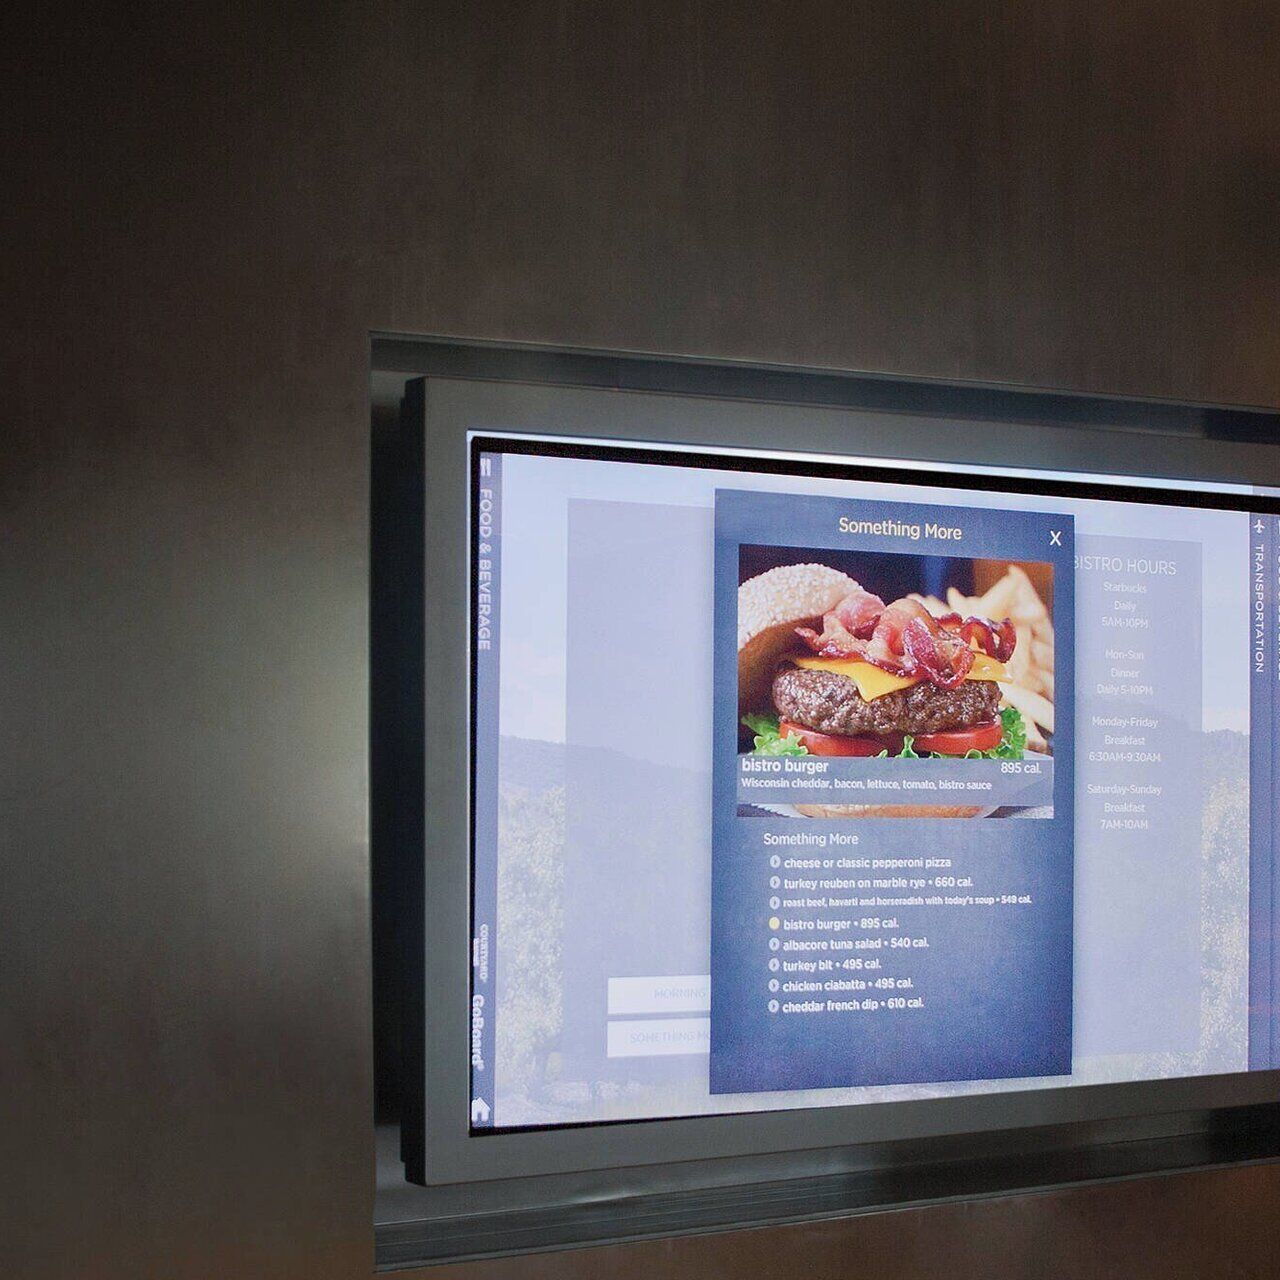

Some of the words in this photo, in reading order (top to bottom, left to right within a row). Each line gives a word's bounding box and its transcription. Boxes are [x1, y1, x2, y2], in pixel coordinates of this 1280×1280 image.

[480, 488, 492, 538] FOOD
[839, 517, 920, 539] Something
[925, 523, 962, 540] More
[480, 543, 491, 554] &
[1127, 559, 1176, 576] HOURS
[1104, 582, 1147, 594] Starbucks
[478, 559, 491, 650] BEVERAGE
[1114, 600, 1136, 613] Daily
[1255, 544, 1264, 673] TRANSPORTATION
[1102, 617, 1149, 629] 5AM-10PM
[1105, 650, 1144, 661] Mon-Sun
[1111, 668, 1141, 679] Dinner
[1097, 684, 1119, 697] Daily
[1120, 685, 1153, 696] 5-10PM
[1092, 717, 1159, 729] Monday-Friday
[1105, 735, 1146, 746] Breakfast
[742, 758, 781, 772] bistro
[785, 760, 829, 775] burger
[1001, 762, 1021, 773] 895
[1024, 762, 1042, 774] cal.
[742, 778, 789, 789] Wisconsin
[791, 778, 833, 790] cheddar,
[835, 779, 865, 790] bacon,
[867, 779, 900, 791] lettuce,
[902, 780, 937, 791] tomato,
[939, 780, 964, 790] bistro
[966, 782, 992, 791] sauce
[1087, 784, 1162, 797] Saturday-Sunday
[1104, 802, 1145, 813] Breakfast
[1101, 819, 1148, 830] 7AM-10AM
[764, 833, 826, 846] Something
[829, 833, 858, 845] More
[784, 858, 820, 868] cheese
[823, 860, 834, 868] or
[836, 857, 870, 868] classic
[872, 857, 923, 870] pepperoni
[925, 858, 952, 870] pizza
[784, 879, 817, 890] turkey
[820, 878, 856, 888] reuben
[858, 880, 870, 888] on
[873, 878, 907, 888] marble
[910, 880, 926, 890] rye
[935, 877, 955, 887] 660
[957, 877, 973, 886] cal.
[783, 899, 804, 907] roast
[806, 898, 828, 908] beef,
[829, 897, 858, 906] havarti
[859, 897, 875, 906] and
[876, 896, 924, 906] horseradish
[925, 896, 943, 905] with
[945, 896, 973, 906] today's
[975, 896, 994, 906] soup
[1018, 895, 1032, 904] cal.
[784, 920, 814, 930] bistro
[817, 919, 850, 931] burger
[861, 918, 880, 928] 895
[882, 918, 899, 928] cal.
[783, 940, 828, 950] albacore
[830, 940, 853, 949] tuna
[855, 939, 881, 949] salad
[890, 938, 911, 948] 540
[912, 938, 929, 948] cal.
[783, 960, 816, 972] turkey
[843, 959, 863, 970] 495
[864, 959, 881, 969] cal.
[783, 980, 822, 992] chicken
[824, 980, 865, 990] ciabatta
[875, 979, 894, 989] 495
[896, 978, 913, 988] cal.
[783, 1002, 824, 1013] cheddar
[826, 1000, 860, 1011] french
[862, 999, 878, 1011] dip
[888, 998, 905, 1008] 610
[907, 998, 924, 1008] cal.
[473, 994, 485, 1068] GoBoard
